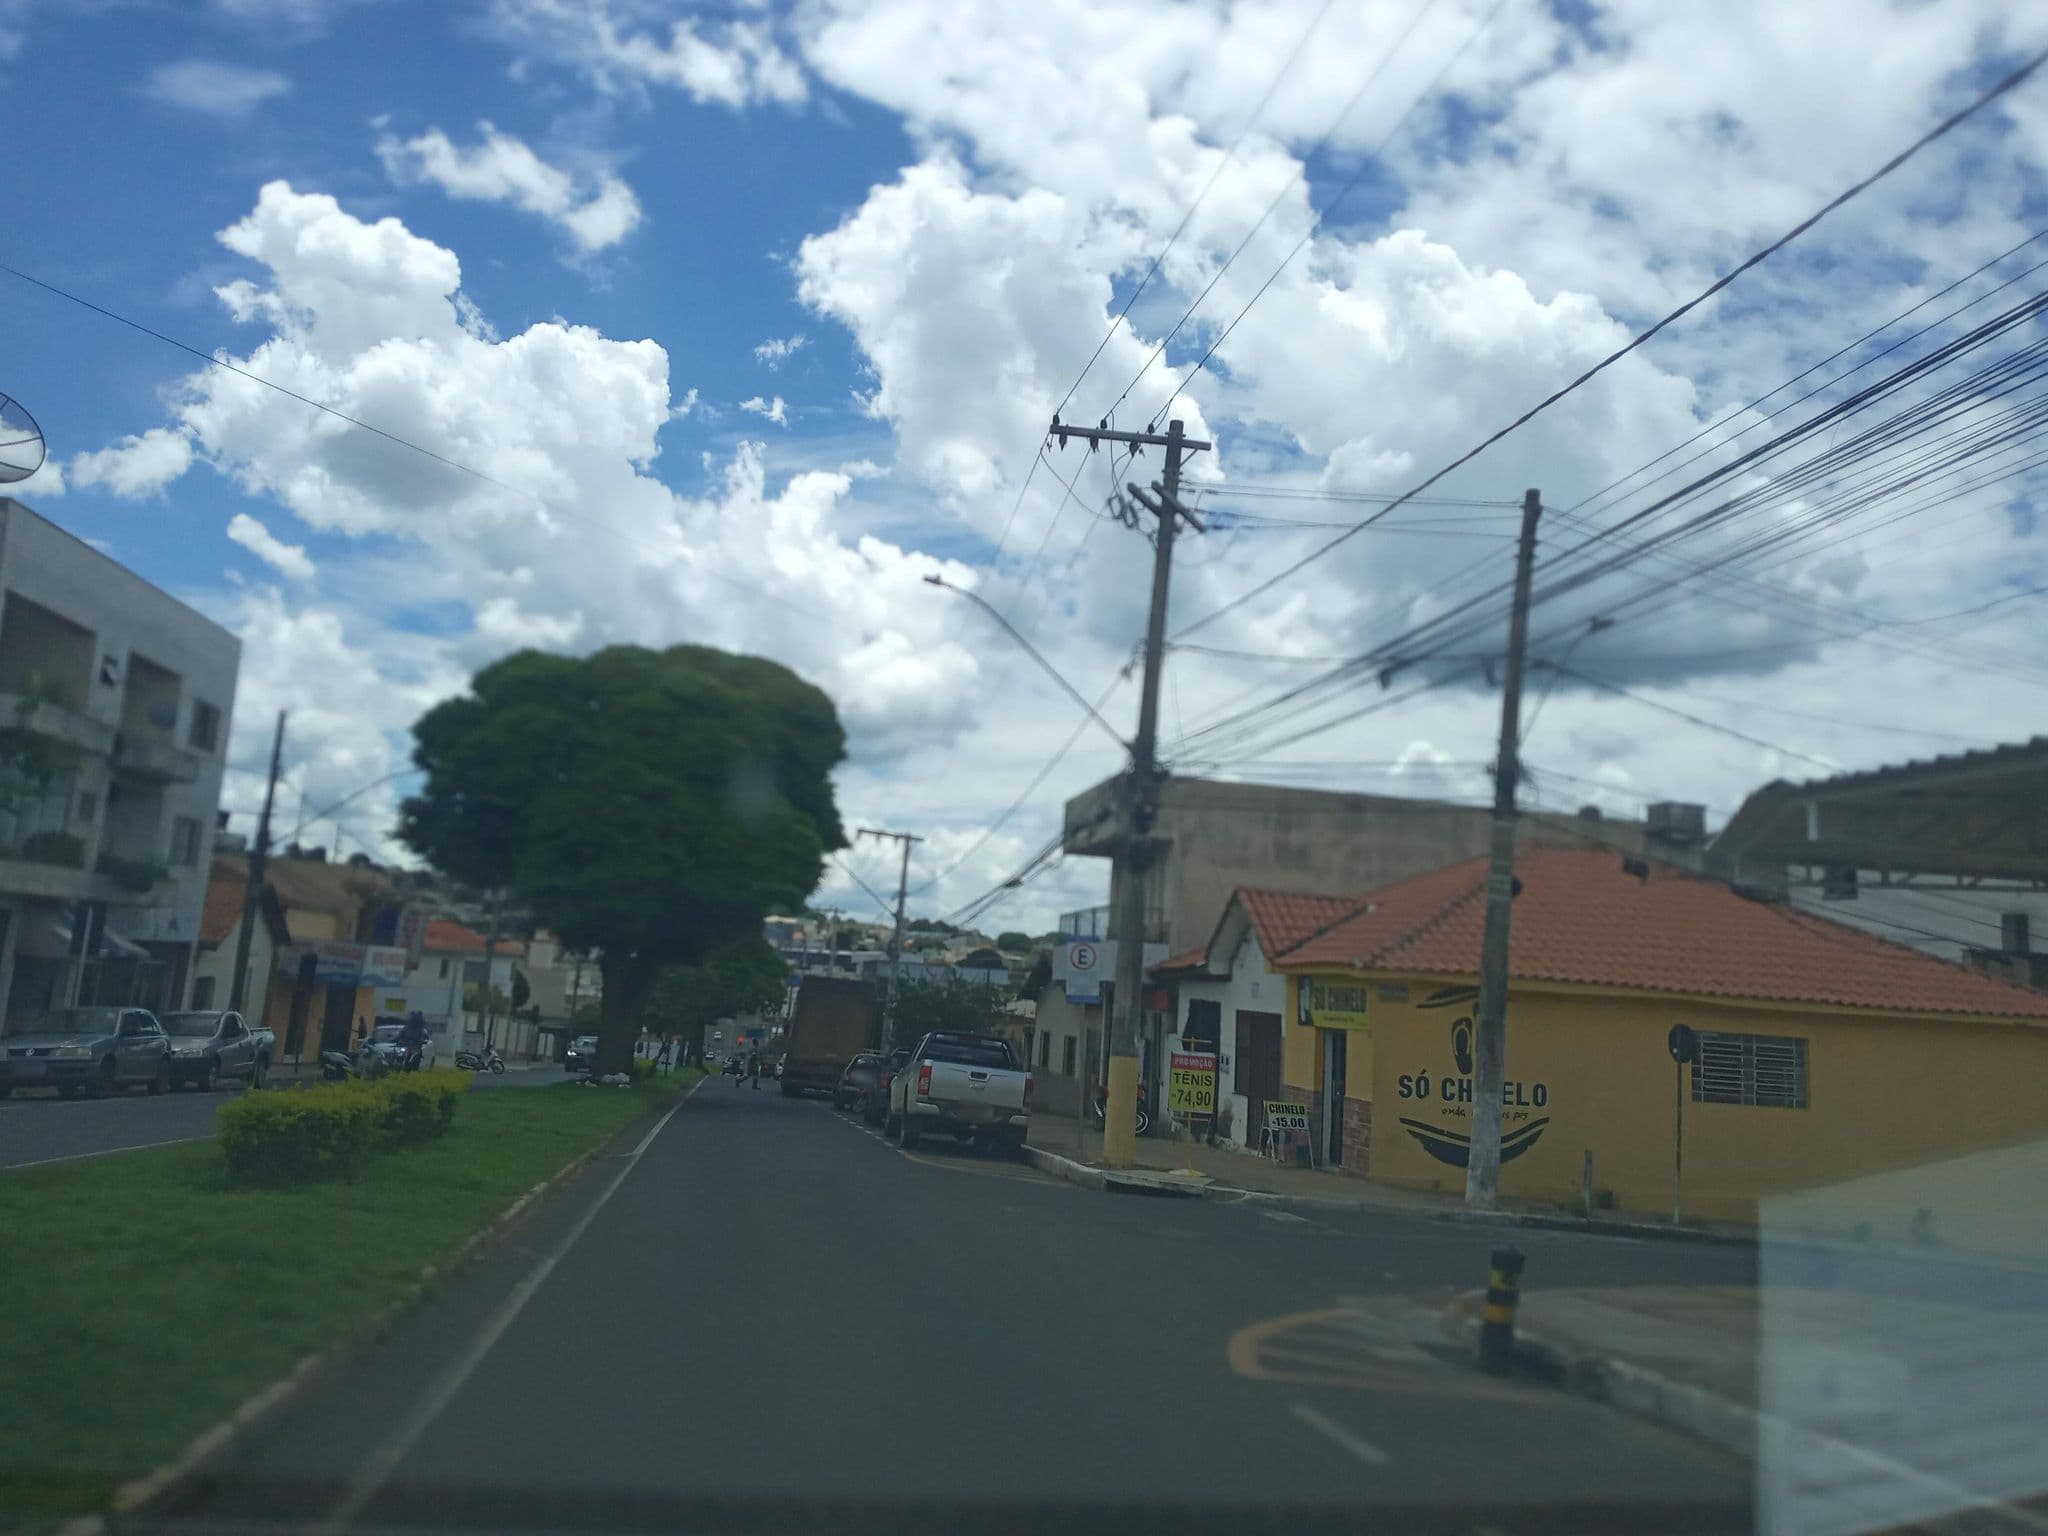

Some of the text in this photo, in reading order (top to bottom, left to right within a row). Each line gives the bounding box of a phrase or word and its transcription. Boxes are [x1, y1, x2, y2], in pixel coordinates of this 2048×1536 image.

[1078, 948, 1089, 965] E
[1173, 1070, 1213, 1087] TÊNIS
[1398, 1067, 1430, 1099] SÓ
[1269, 1103, 1305, 1115] CHINELO
